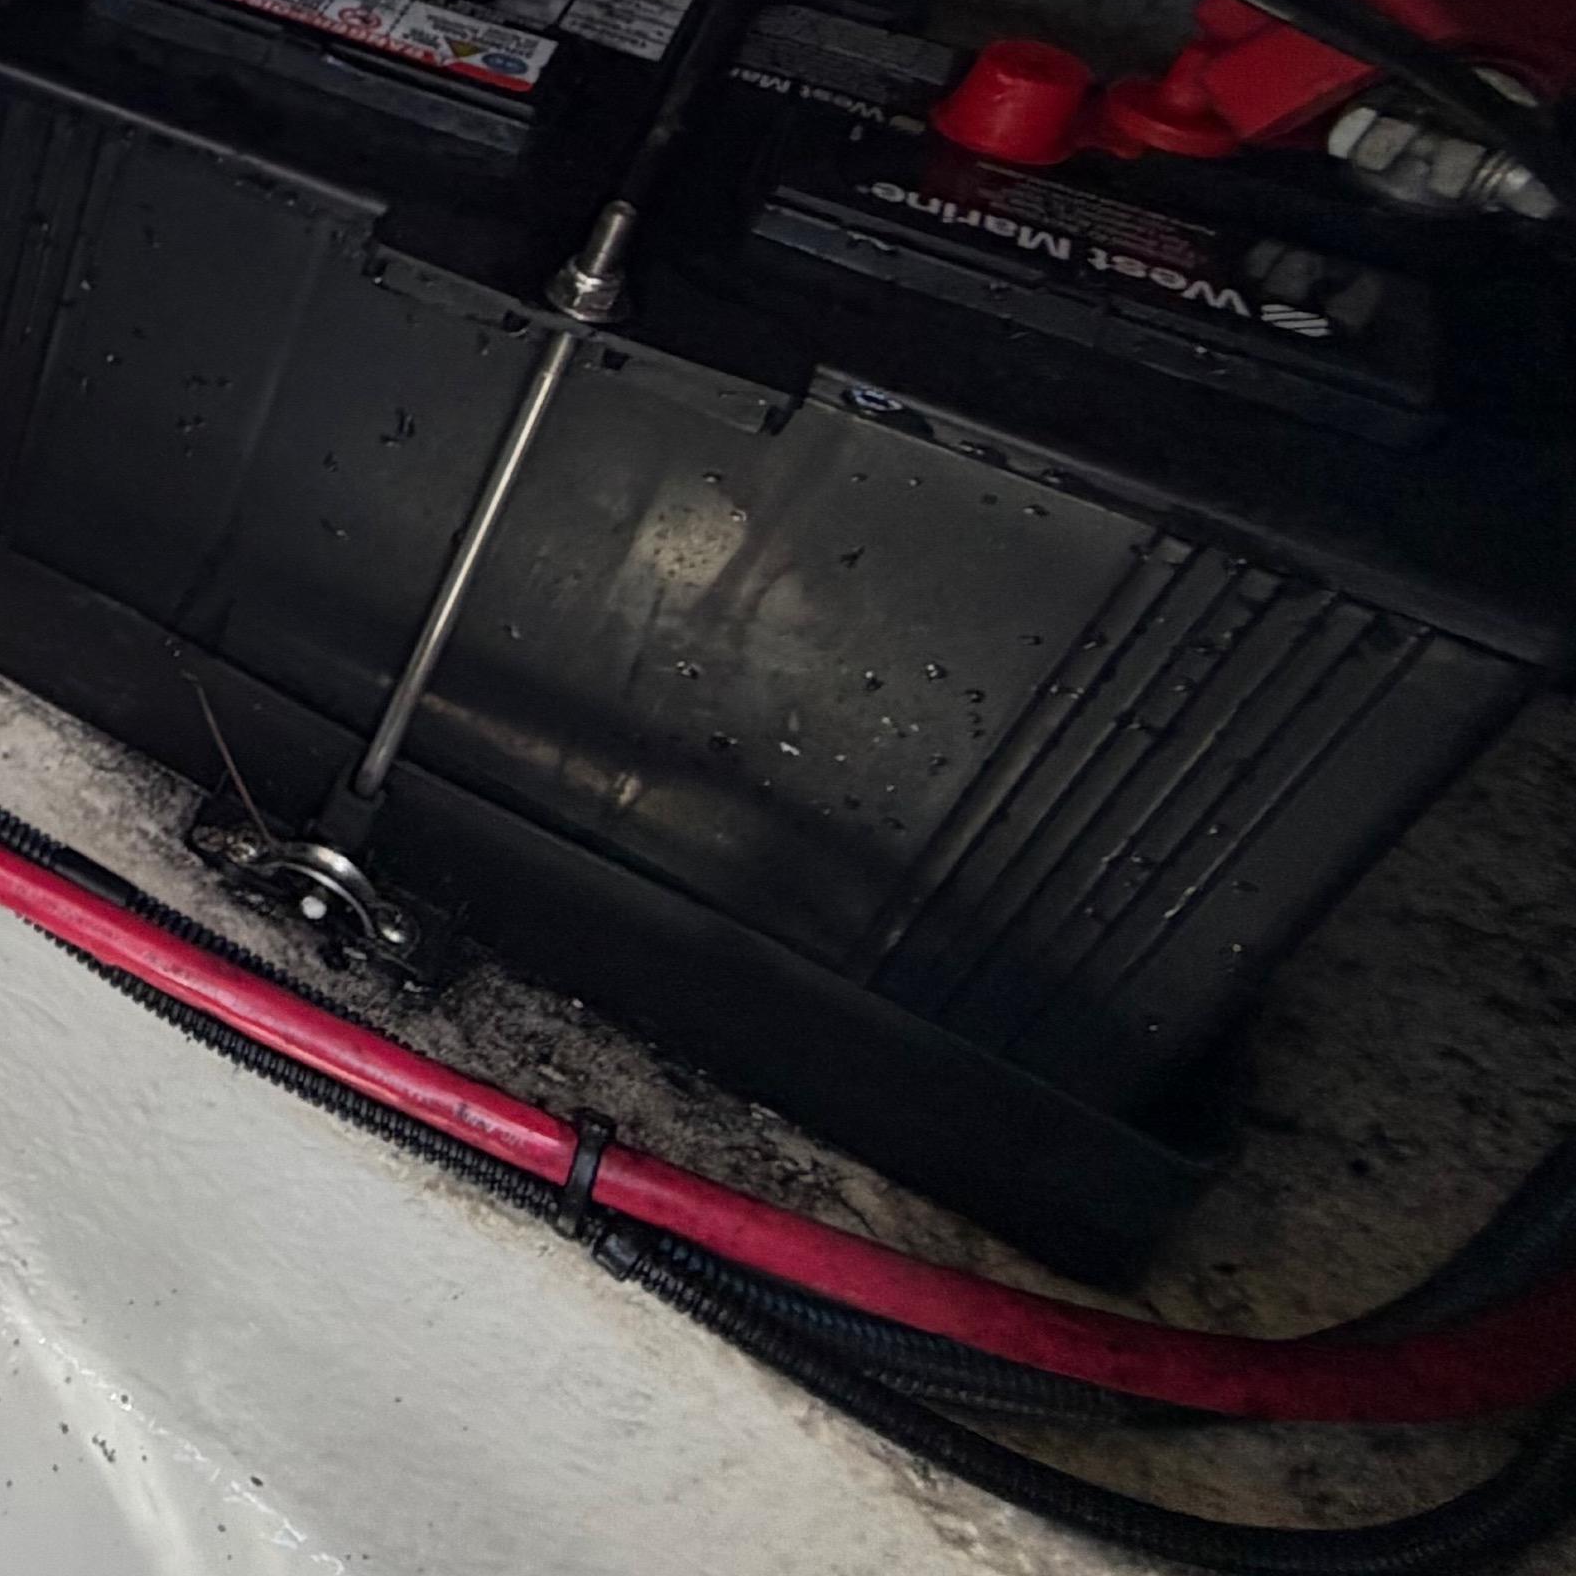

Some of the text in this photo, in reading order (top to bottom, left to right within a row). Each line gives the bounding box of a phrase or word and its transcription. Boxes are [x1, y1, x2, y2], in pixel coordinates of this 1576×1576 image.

[796, 84, 886, 124] West
[863, 180, 1073, 262] Marine
[1084, 245, 1252, 319] West
